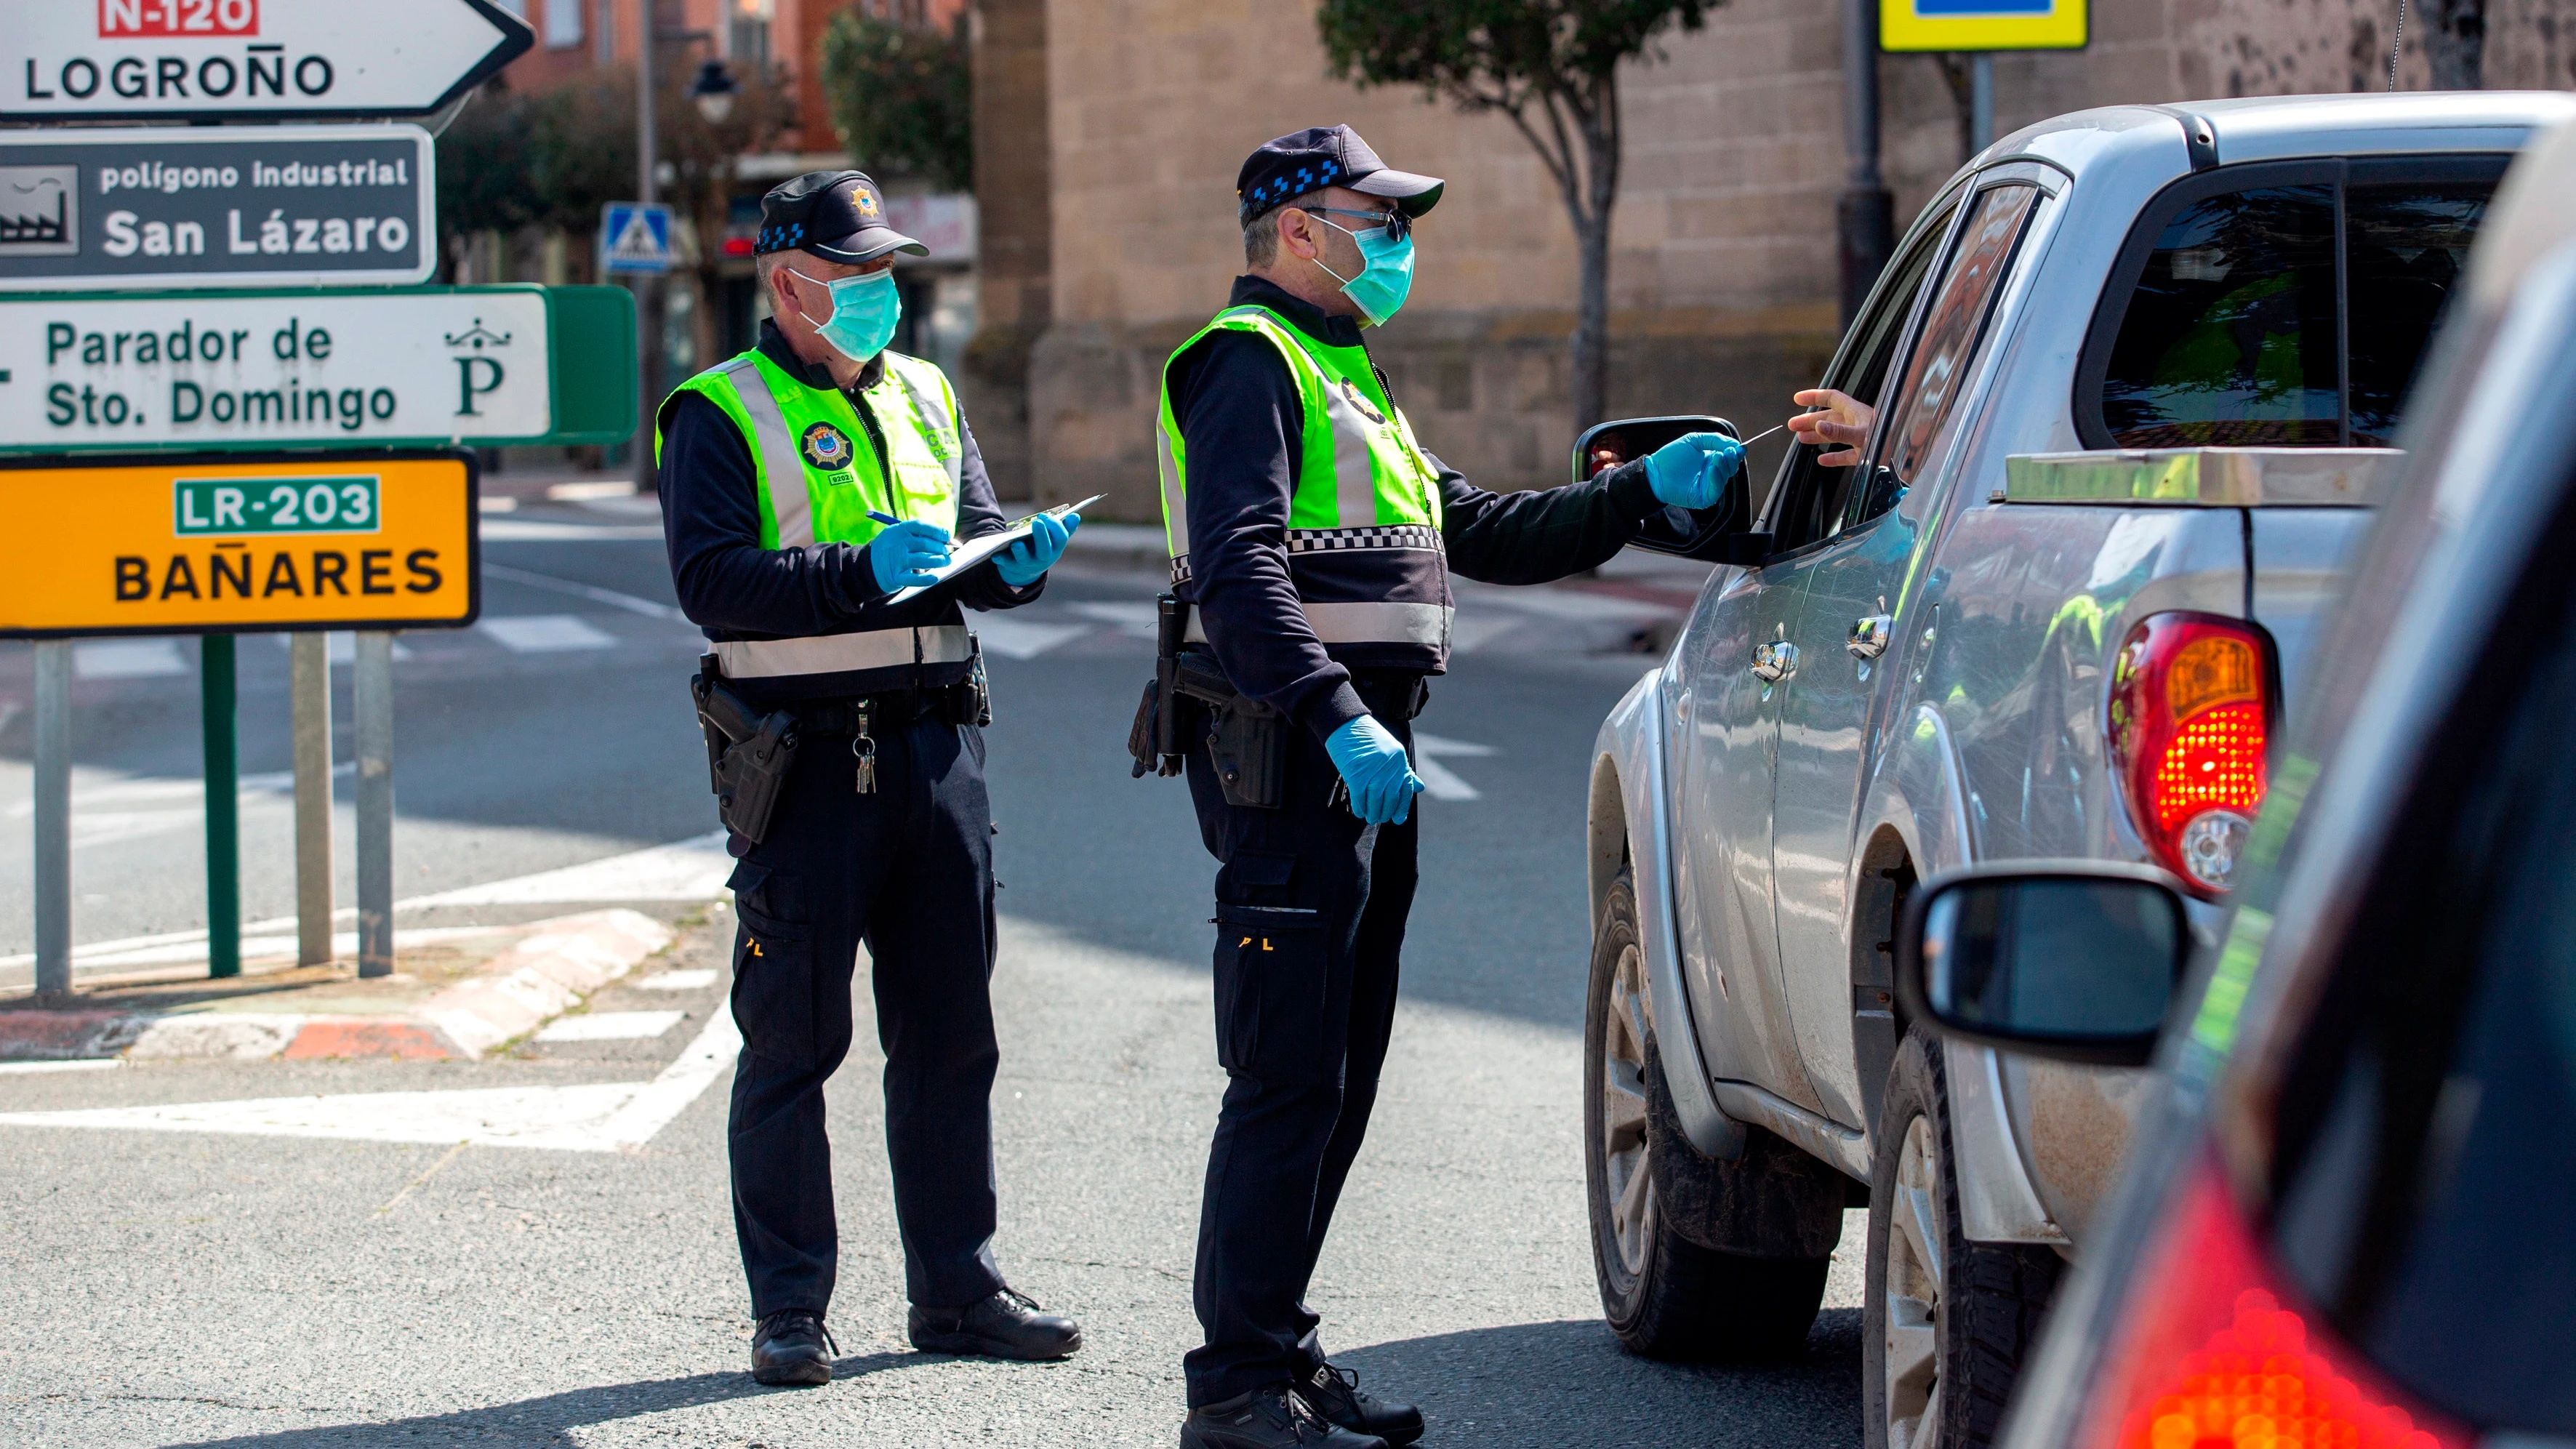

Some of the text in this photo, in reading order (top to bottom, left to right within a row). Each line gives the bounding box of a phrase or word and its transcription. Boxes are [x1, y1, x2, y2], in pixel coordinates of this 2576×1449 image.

[104, 0, 253, 31] N-120
[26, 44, 335, 99] LOGROÑO
[100, 158, 409, 195] polígono industrial
[103, 208, 410, 257] San Lázaro
[47, 318, 332, 364] Parador de
[47, 379, 397, 430] Sto. Domingo
[926, 431, 955, 447] CIA
[832, 474, 850, 483] 9202
[182, 484, 372, 527] LR-203
[115, 542, 443, 601] BAÑARES
